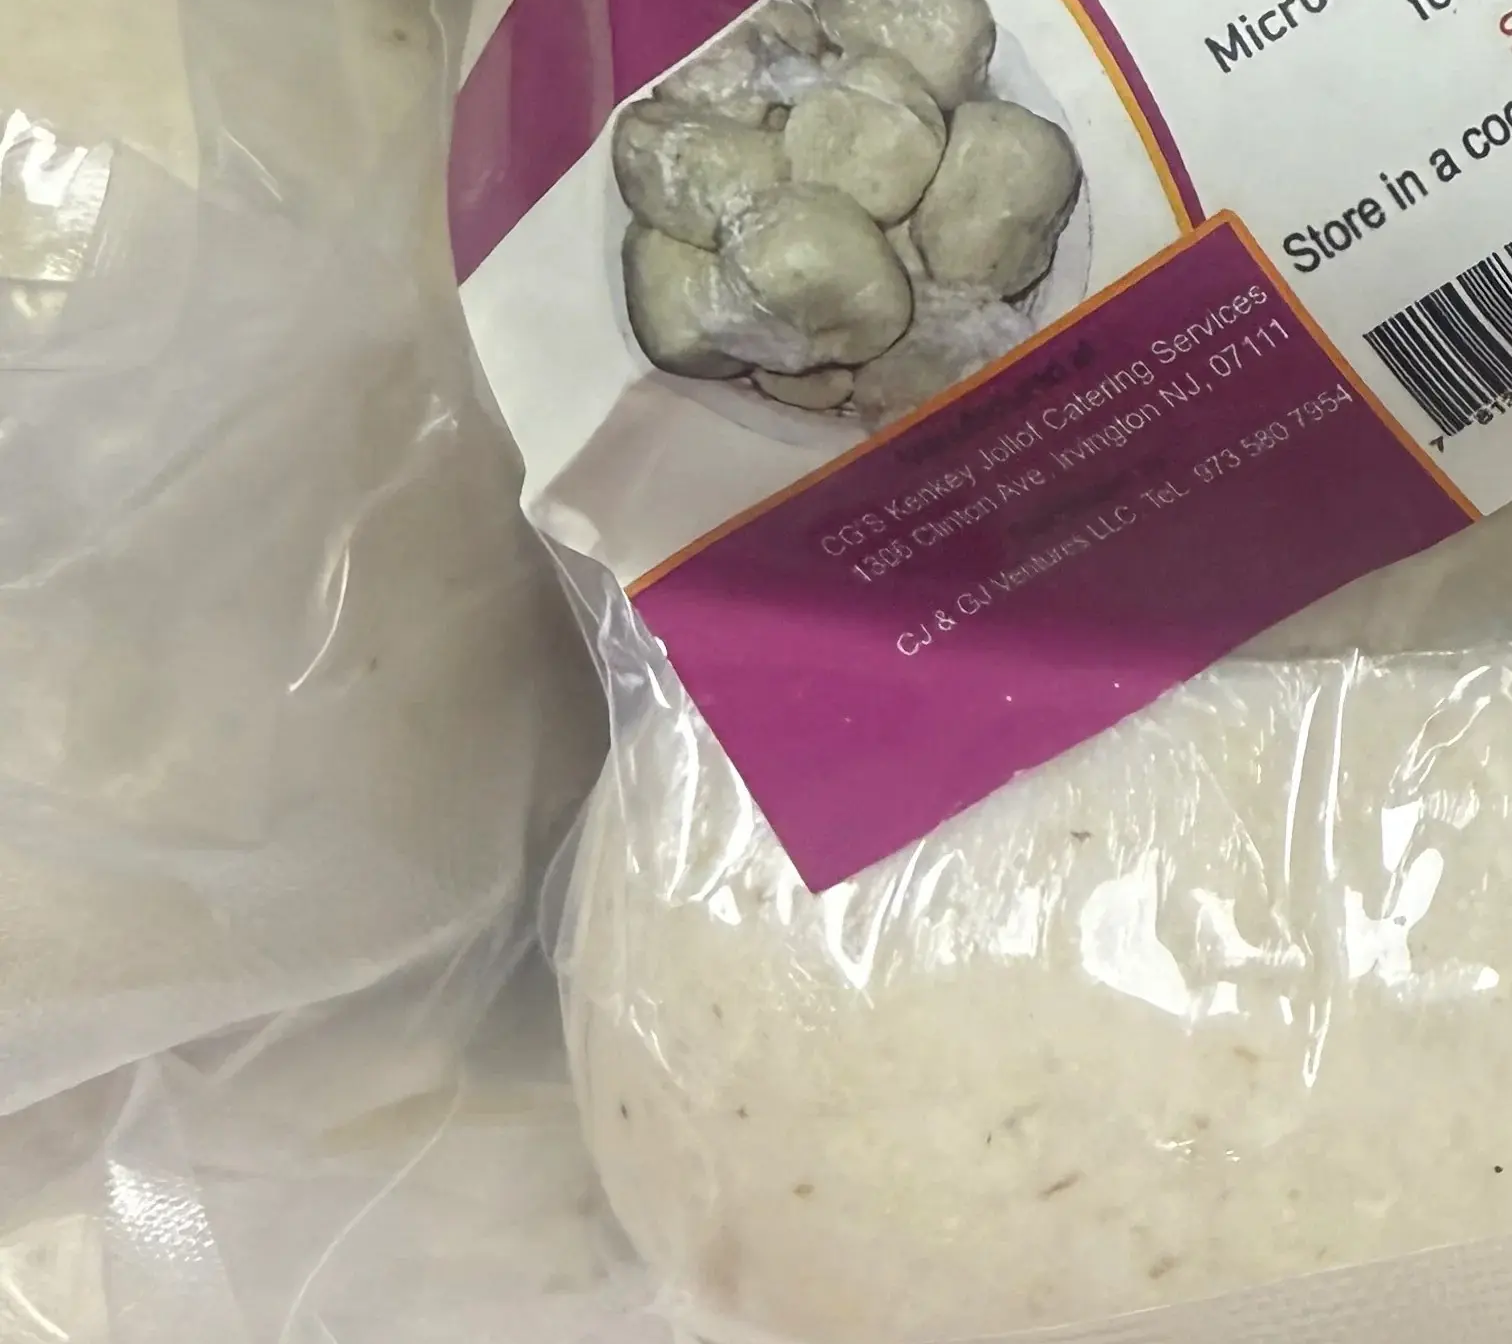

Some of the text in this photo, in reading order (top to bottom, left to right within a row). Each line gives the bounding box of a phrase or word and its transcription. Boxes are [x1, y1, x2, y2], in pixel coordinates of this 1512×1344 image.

[1283, 197, 1386, 273] Store
[1379, 170, 1428, 210] in
[1429, 148, 1462, 182] a
[884, 465, 976, 521] Kenkey
[1042, 360, 1155, 430] Catering
[1151, 285, 1267, 363] Services
[912, 496, 998, 546] Clinton
[1050, 403, 1161, 471] Irvington
[1159, 372, 1213, 407] NJ,
[1209, 318, 1289, 377] 07111
[1429, 436, 1445, 453] 7
[896, 623, 932, 656] CJ
[935, 610, 957, 631] &
[957, 584, 992, 615] GJ
[990, 534, 1091, 592] Ventures
[1194, 448, 1241, 483] 973
[1240, 421, 1289, 456] 580
[1287, 384, 1353, 428] 7954
